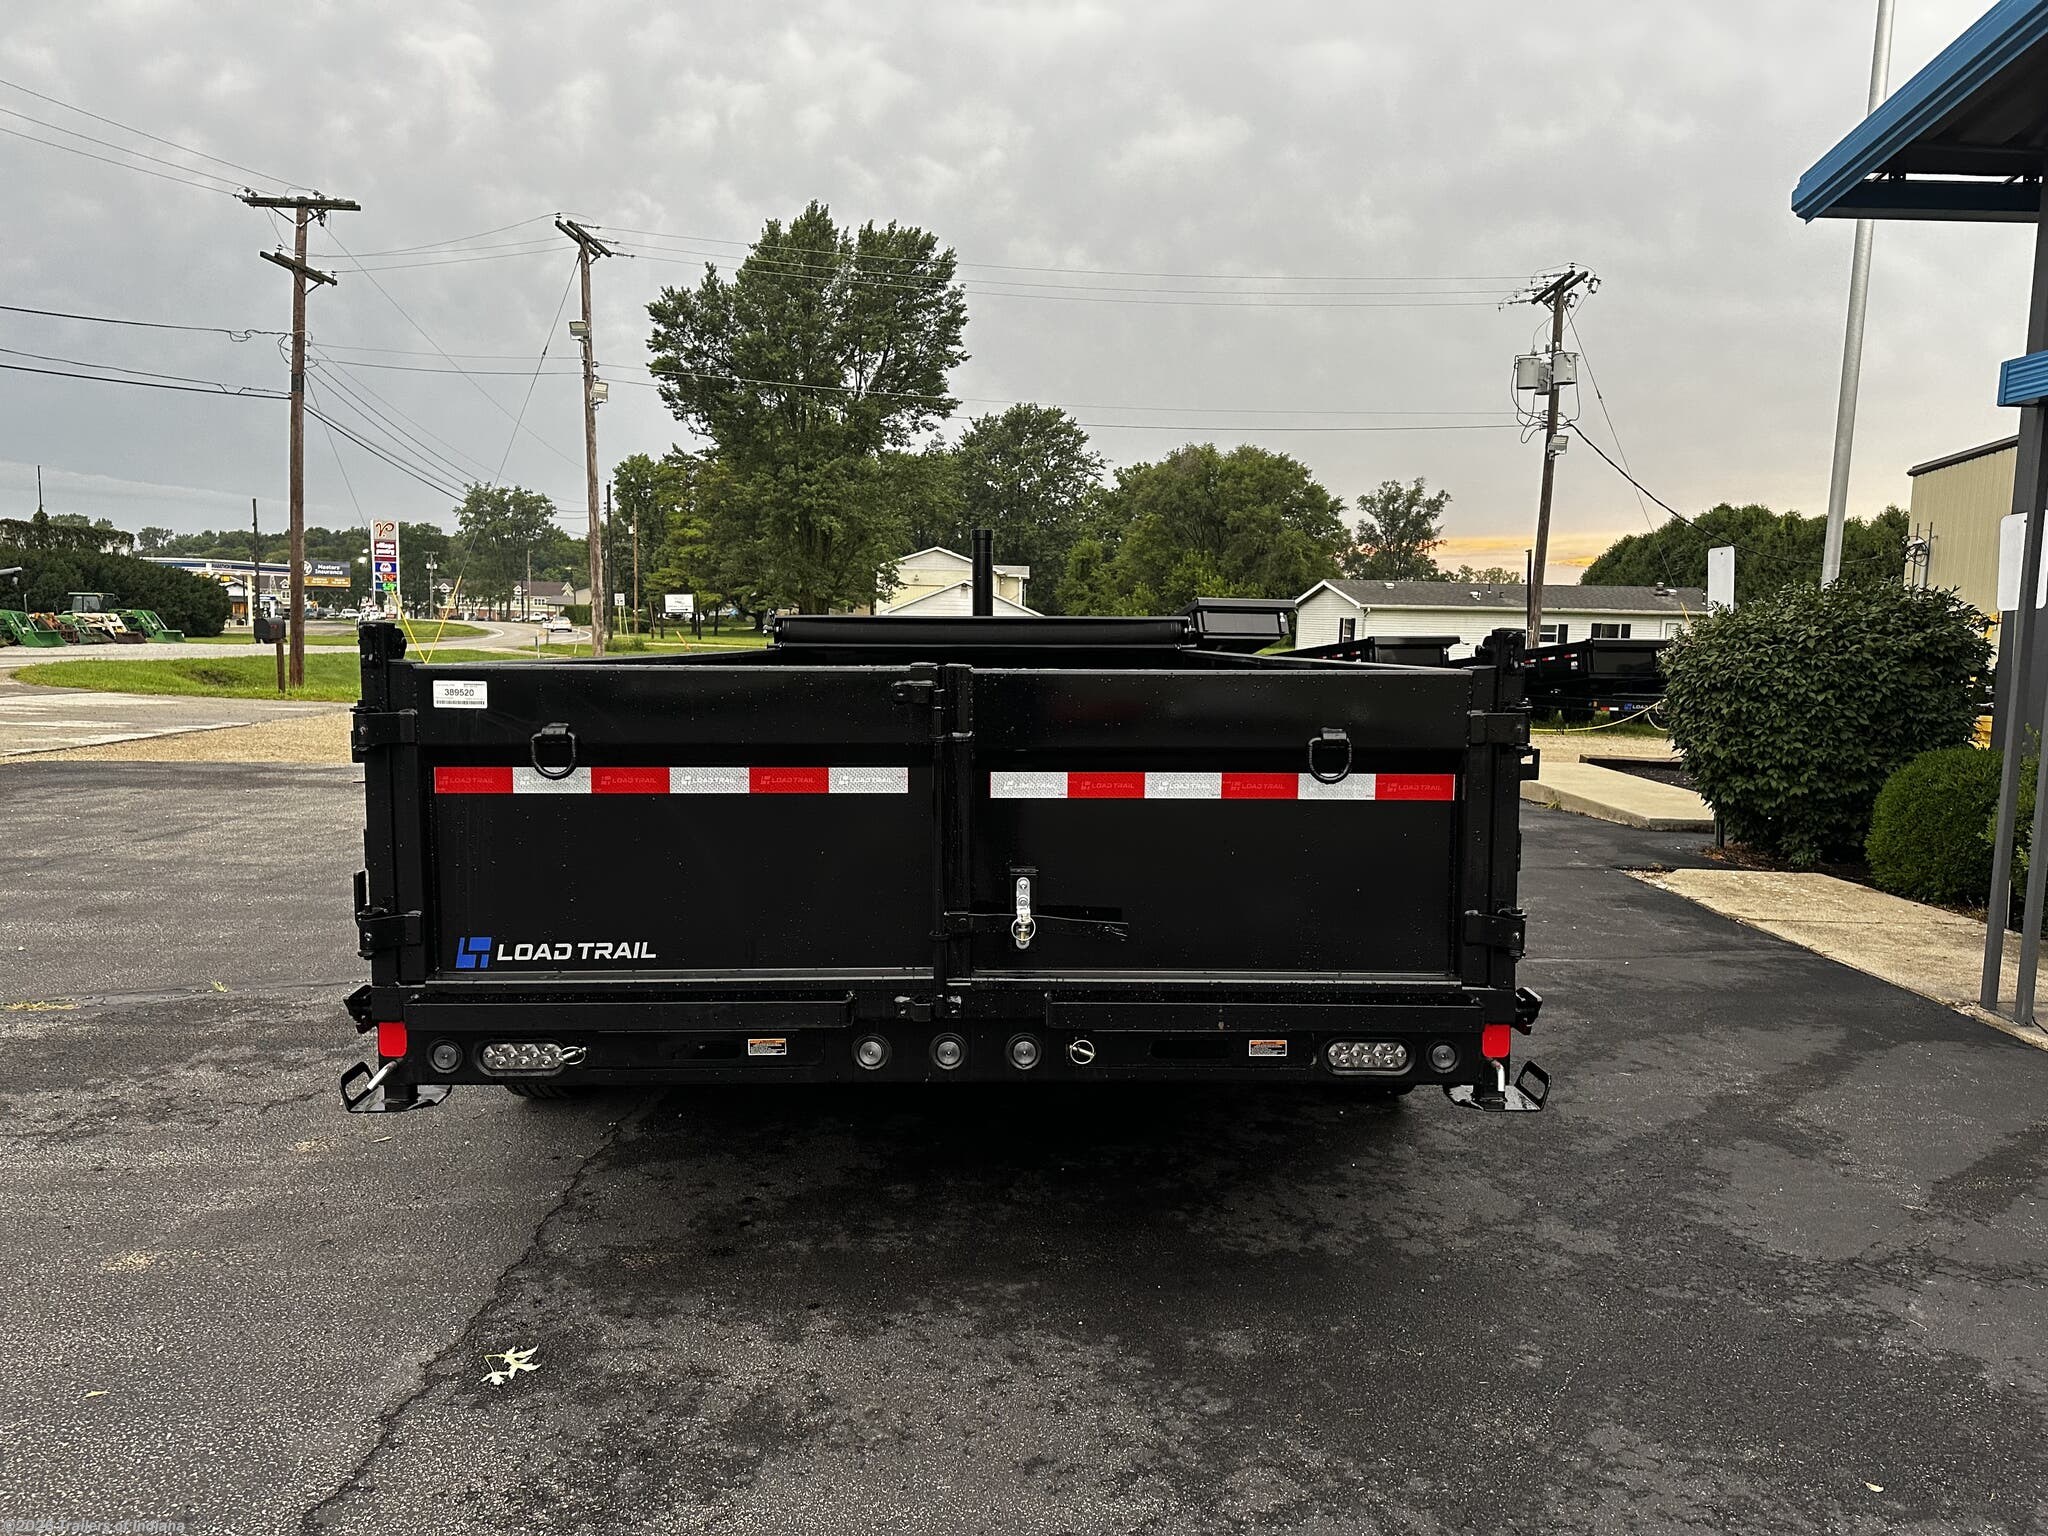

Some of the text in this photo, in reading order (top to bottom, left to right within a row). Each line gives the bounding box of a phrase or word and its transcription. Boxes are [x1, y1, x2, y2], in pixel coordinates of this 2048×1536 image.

[444, 688, 475, 697] 389520
[497, 942, 657, 961] LOAD TRAIL
